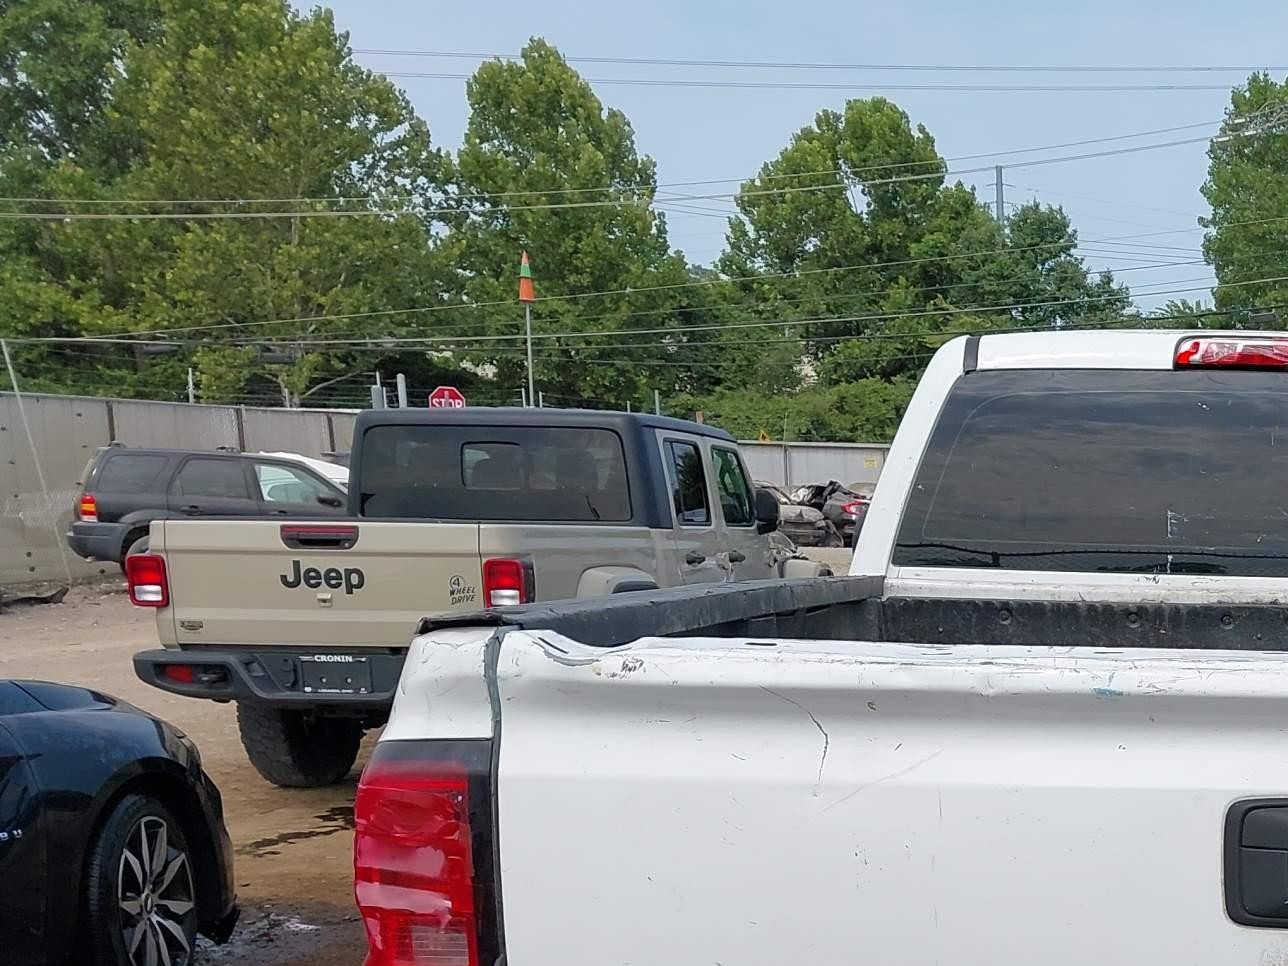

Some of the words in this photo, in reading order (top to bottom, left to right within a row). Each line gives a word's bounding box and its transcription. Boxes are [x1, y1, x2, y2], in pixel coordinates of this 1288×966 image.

[280, 560, 365, 595] Jeep
[450, 586, 475, 597] WHEEL
[451, 595, 476, 605] DRIVE
